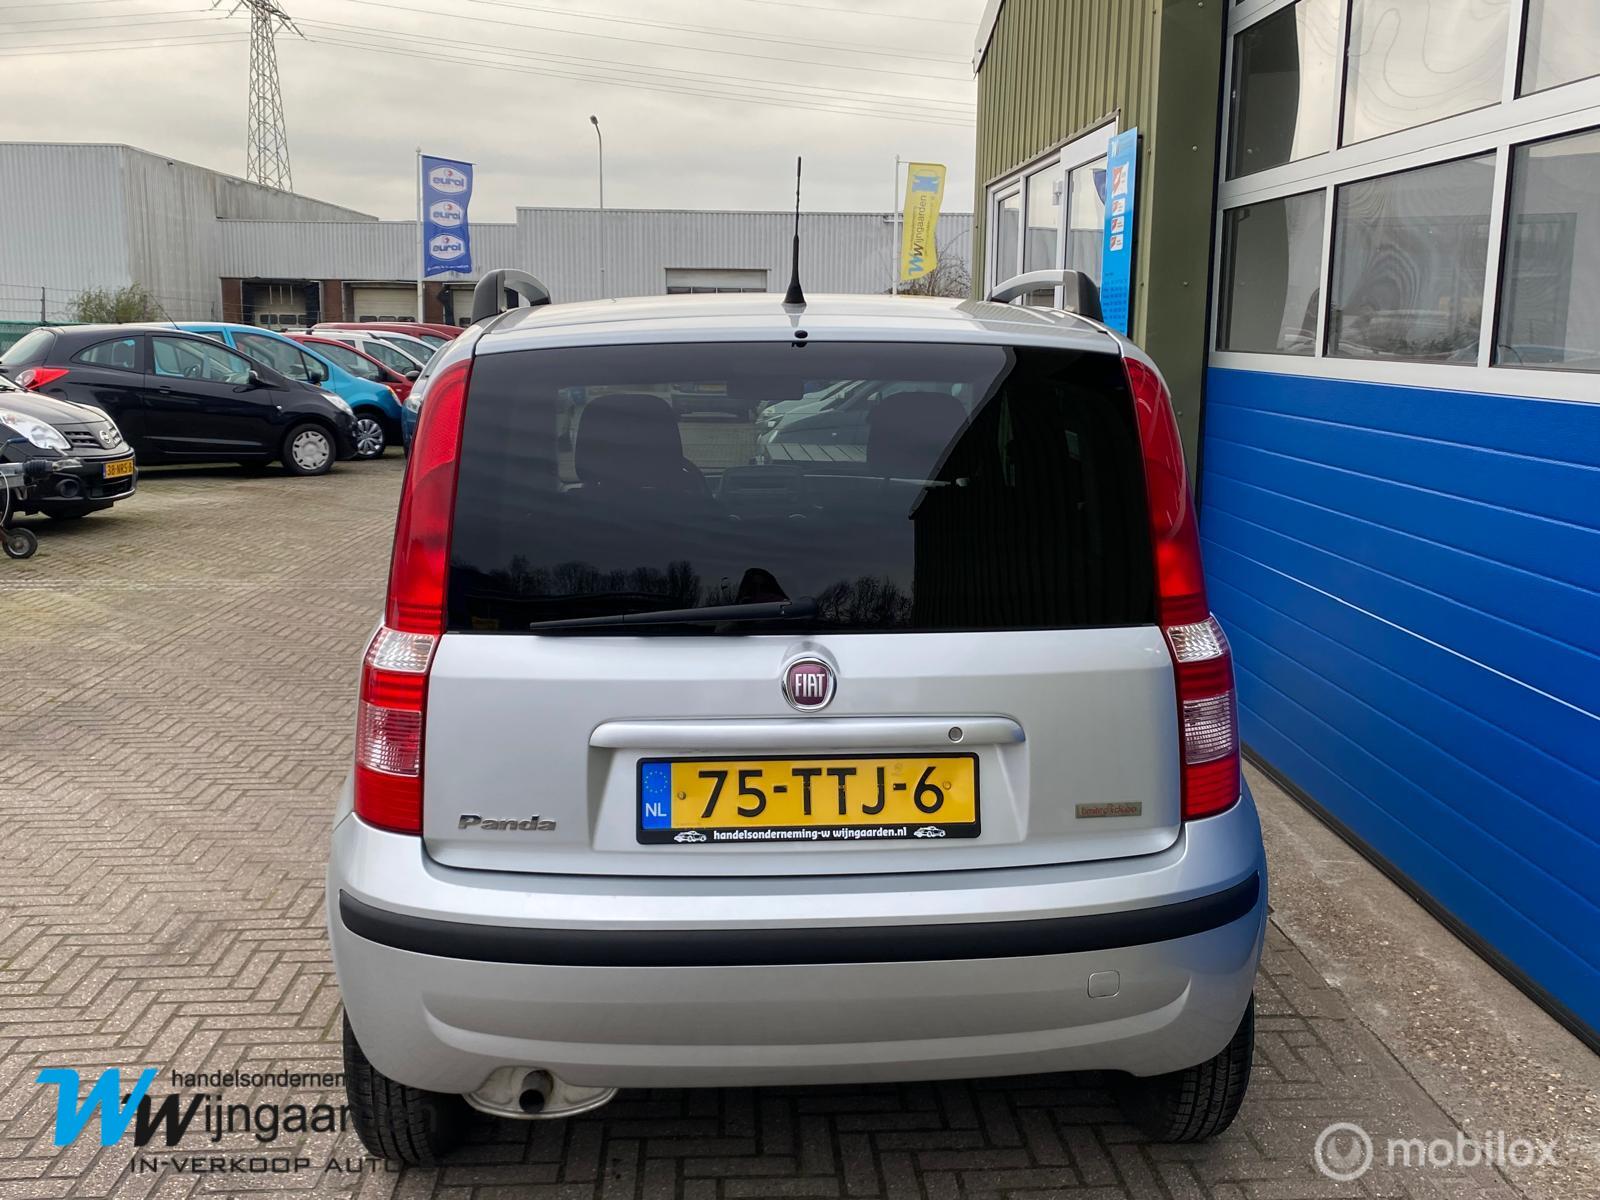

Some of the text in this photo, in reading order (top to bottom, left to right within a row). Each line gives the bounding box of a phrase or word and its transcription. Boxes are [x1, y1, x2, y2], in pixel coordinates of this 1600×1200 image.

[432, 177, 465, 187] eurol
[432, 211, 461, 221] eurol
[432, 243, 462, 252] eurol
[795, 673, 825, 697] FIAT
[698, 766, 945, 818] 75-TTJ-6
[645, 803, 667, 817] NL
[458, 814, 557, 831] Panda
[833, 827, 907, 839] wijngaarden.nl
